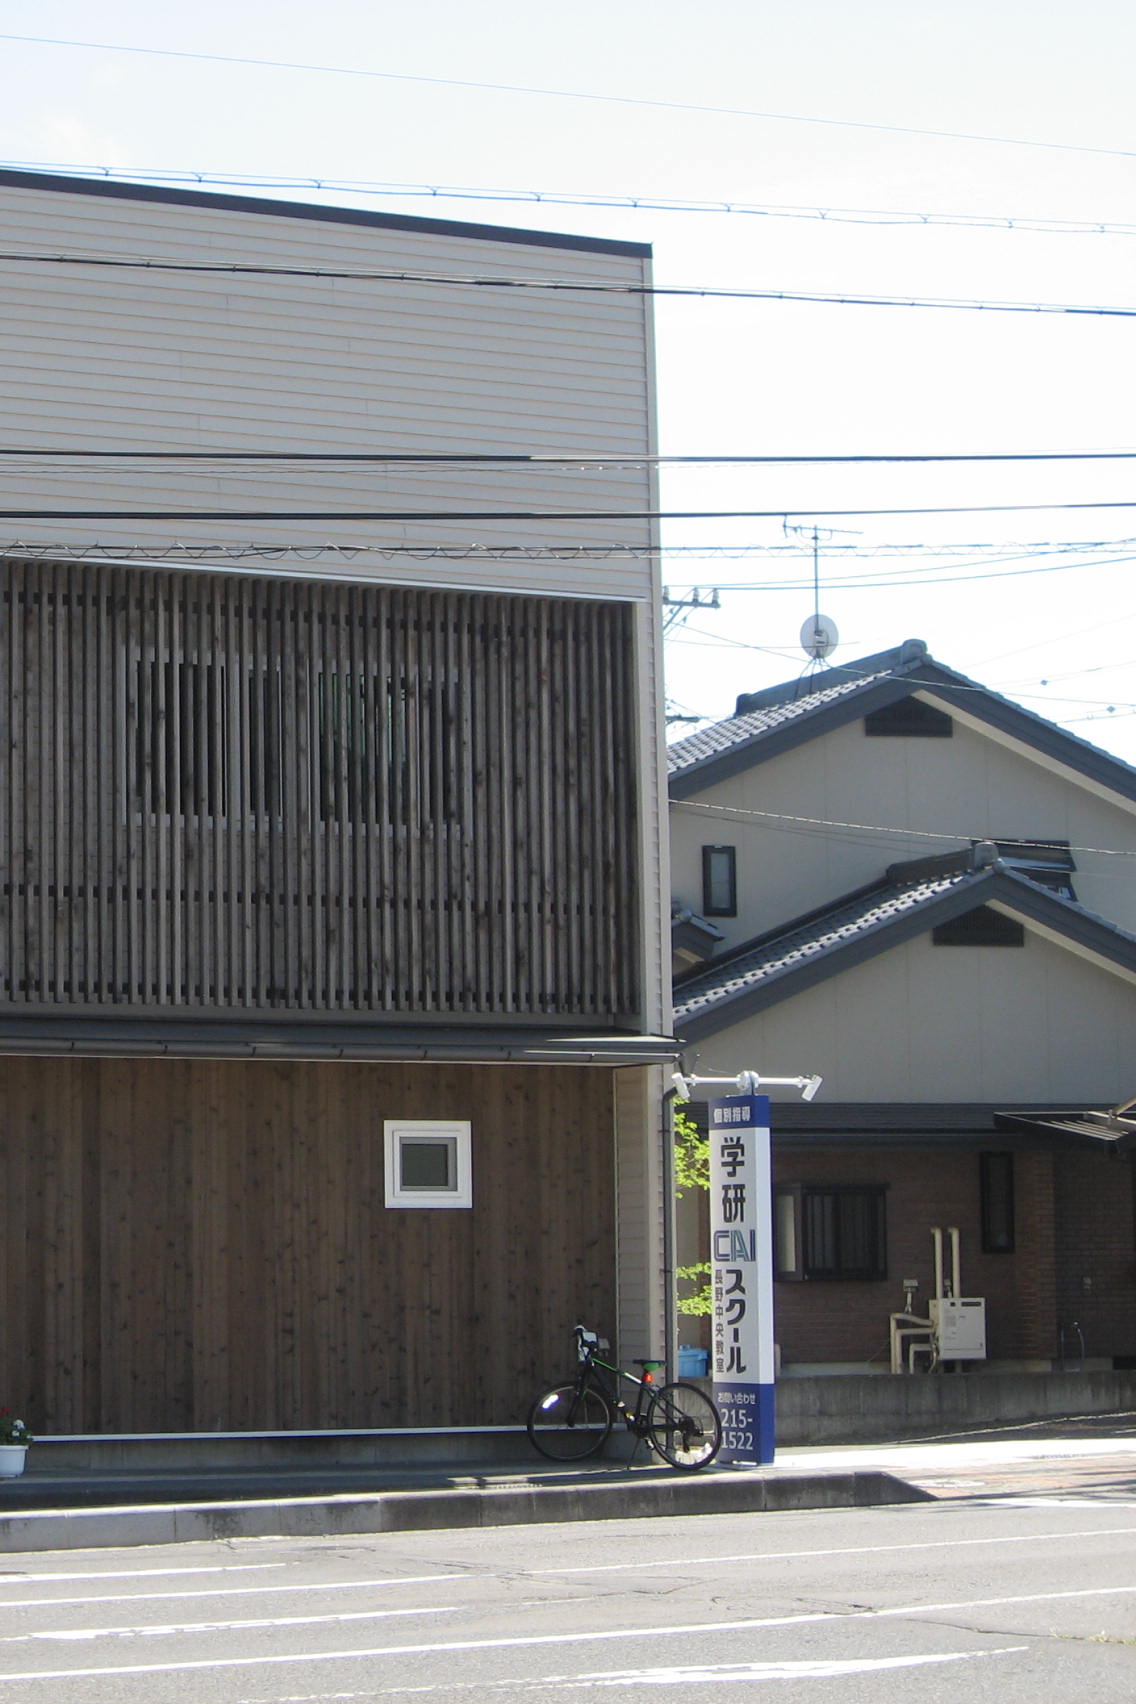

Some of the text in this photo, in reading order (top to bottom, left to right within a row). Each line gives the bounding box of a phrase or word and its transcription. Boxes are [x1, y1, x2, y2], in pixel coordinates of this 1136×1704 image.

[714, 1106, 751, 1123] 個別指導
[715, 1269, 724, 1373] 長野中央教室
[717, 1391, 756, 1405] お問い合わせ
[720, 1408, 753, 1428] 215-
[721, 1432, 754, 1450] 1522
